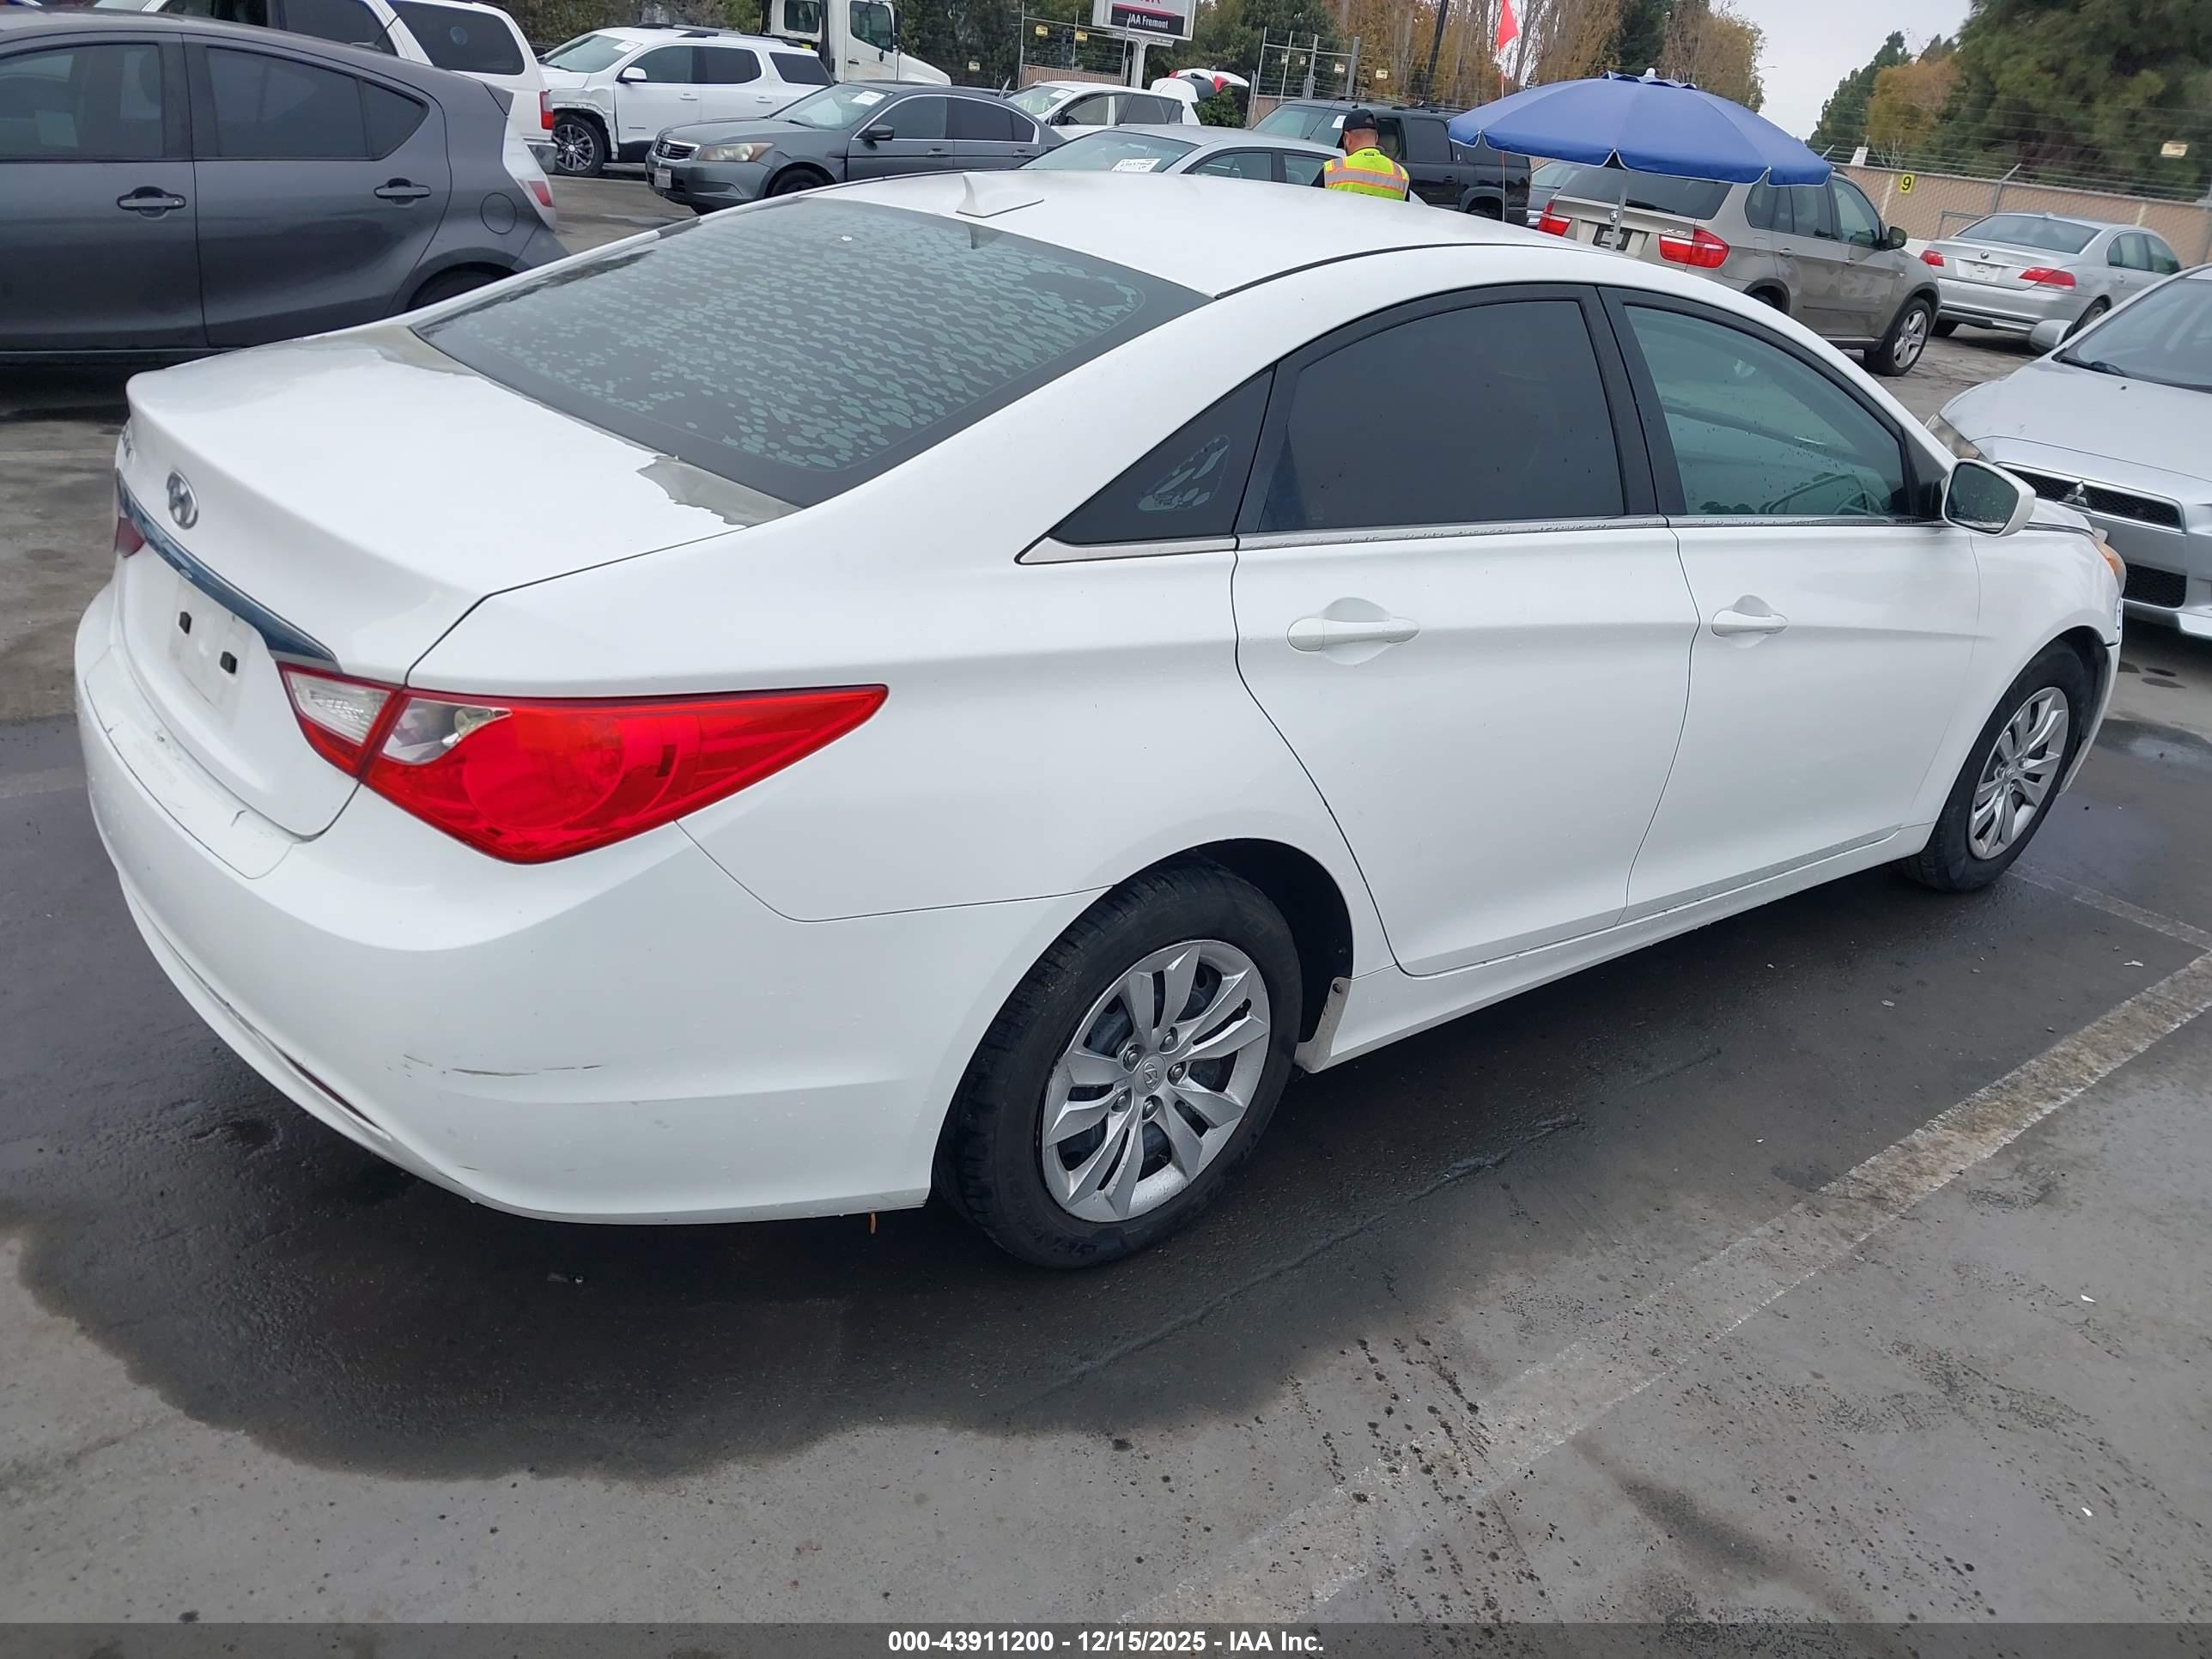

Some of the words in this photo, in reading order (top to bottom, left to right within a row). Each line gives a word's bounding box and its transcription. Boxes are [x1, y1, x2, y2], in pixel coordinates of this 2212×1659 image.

[1127, 13, 1141, 25] IAA
[1142, 15, 1169, 29] Fremont
[1901, 176, 1912, 191] 9
[1662, 228, 1687, 237] X5
